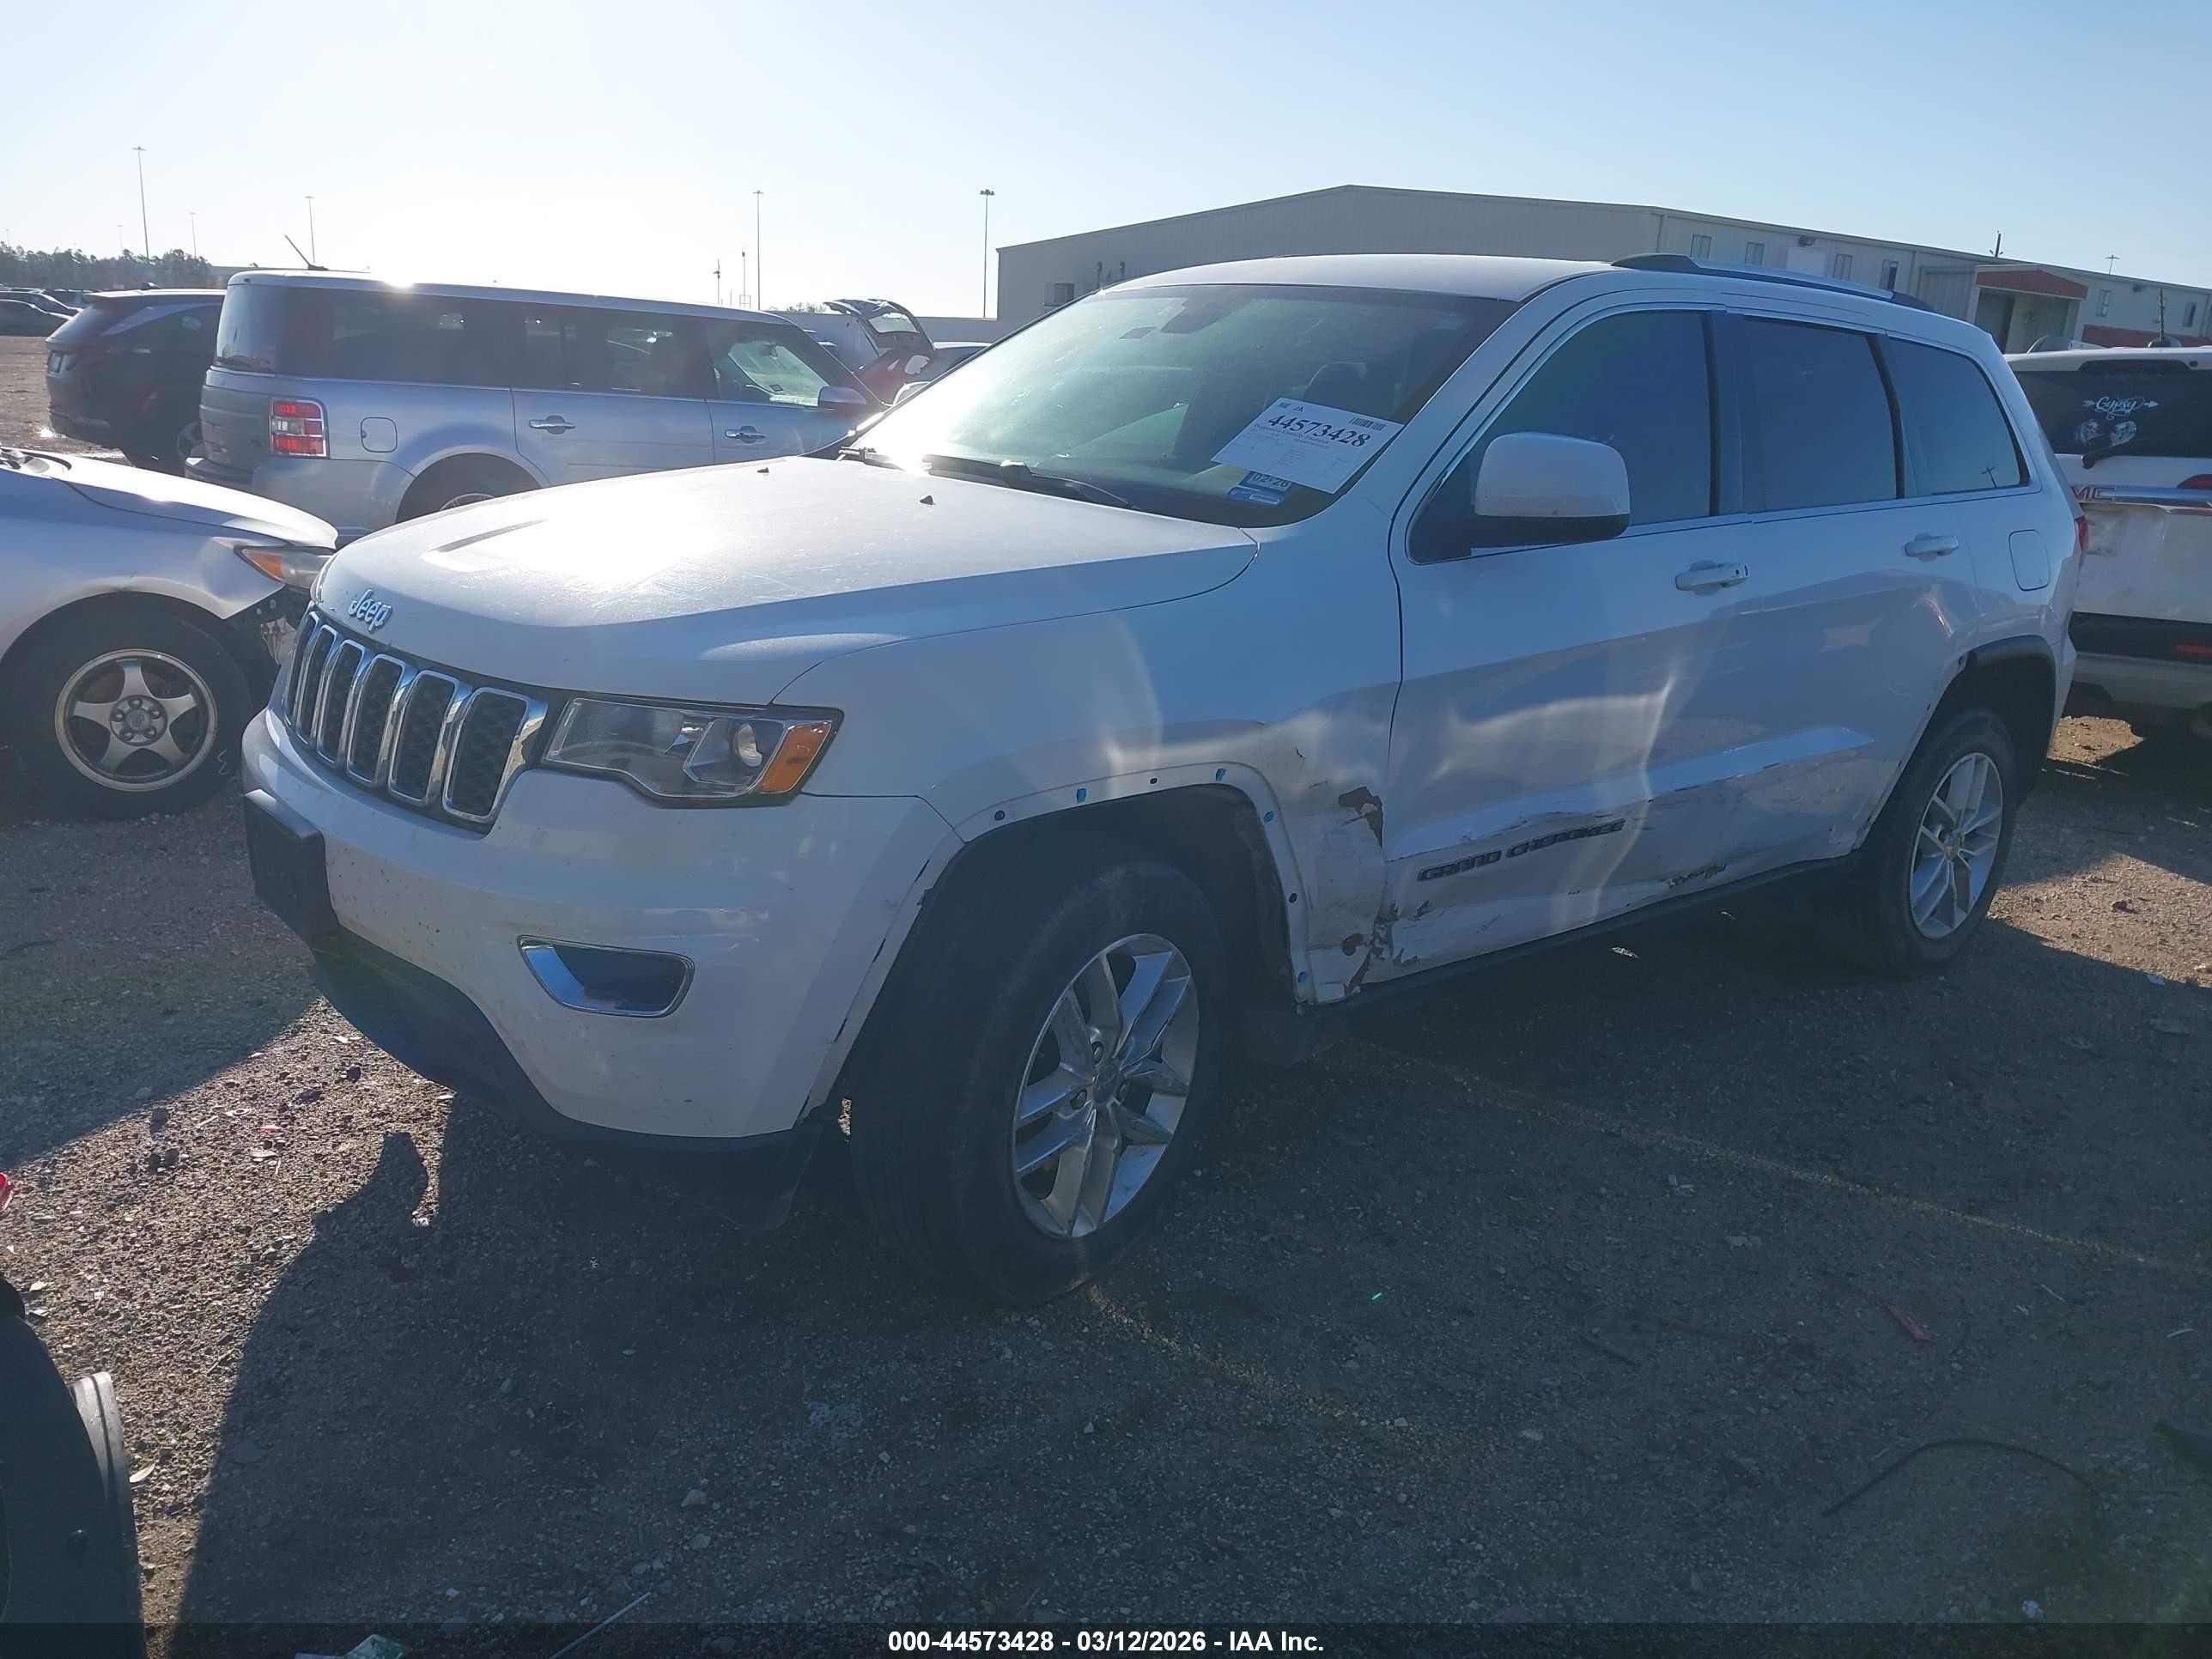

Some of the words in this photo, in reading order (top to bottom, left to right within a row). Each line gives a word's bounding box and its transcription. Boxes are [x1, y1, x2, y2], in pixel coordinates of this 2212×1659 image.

[2095, 396, 2144, 420] Gypsy
[1267, 415, 1371, 447] 44573428
[2069, 484, 2117, 501] MC
[348, 588, 392, 633] Jeep
[1416, 850, 1502, 882] GRAND
[1506, 817, 1626, 858] CHEROKEE
